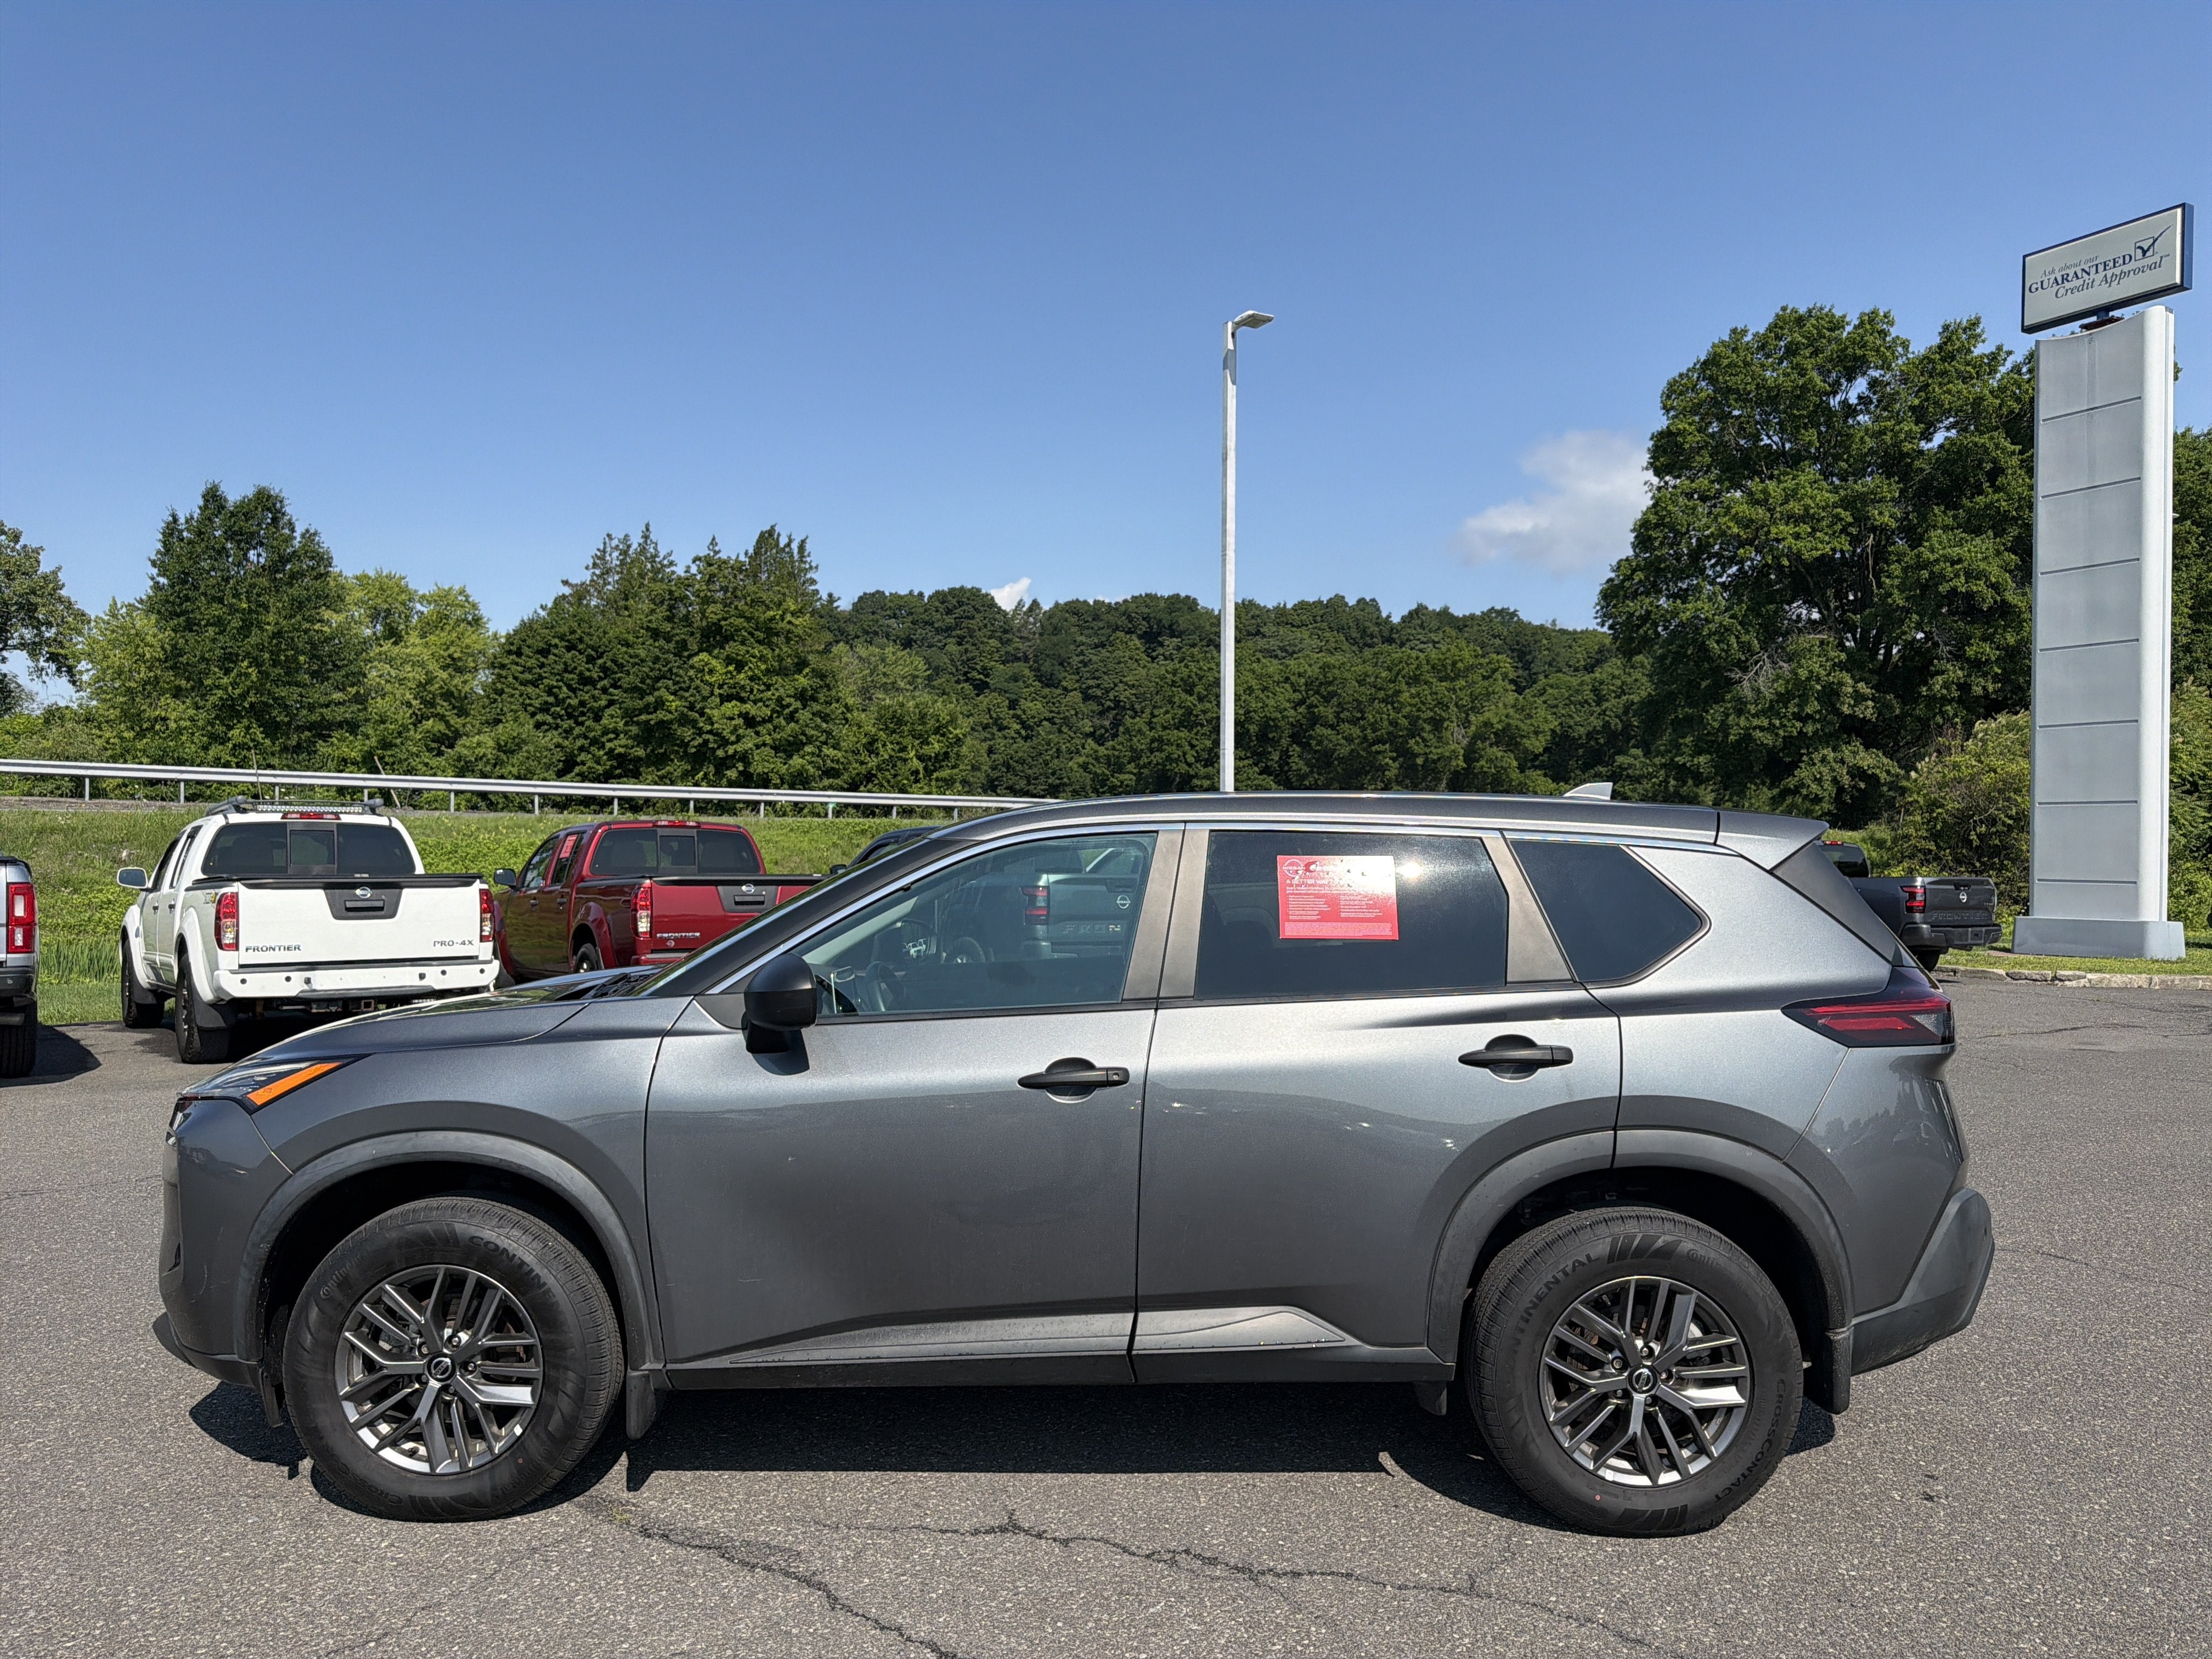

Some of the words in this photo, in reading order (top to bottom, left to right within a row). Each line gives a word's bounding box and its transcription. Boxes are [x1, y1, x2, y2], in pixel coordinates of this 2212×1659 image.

[2028, 253, 2132, 294] GUARANTEED
[2040, 267, 2056, 279] Ask
[2058, 258, 2082, 273] about
[2084, 255, 2100, 265] our
[2055, 277, 2096, 299] Credit
[2097, 255, 2163, 288] Approval
[245, 944, 302, 953] FRONTIER
[433, 939, 475, 947] PRO-4X
